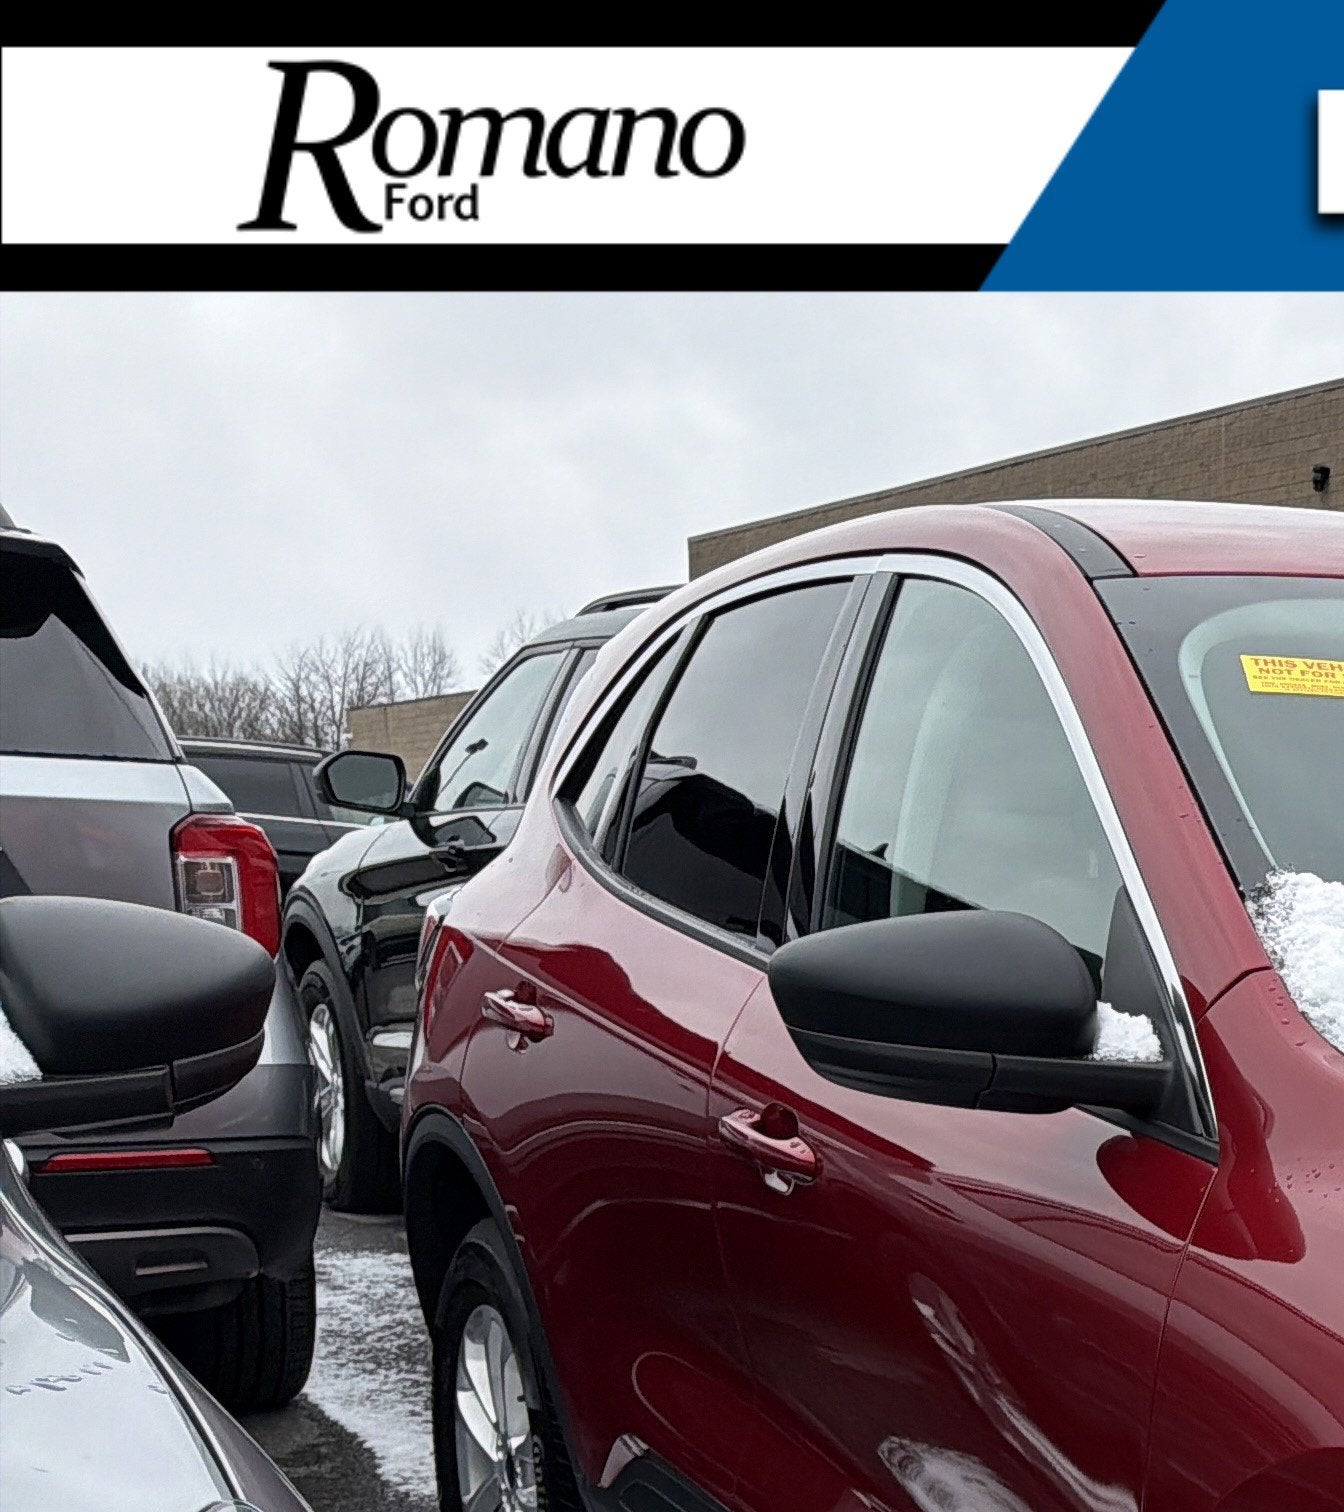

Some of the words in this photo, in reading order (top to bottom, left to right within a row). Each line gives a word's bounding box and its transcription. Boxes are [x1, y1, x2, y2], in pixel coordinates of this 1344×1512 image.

[1251, 658, 1297, 669] THIS
[1258, 667, 1294, 676] NOT
[1300, 670, 1336, 679] FOR
